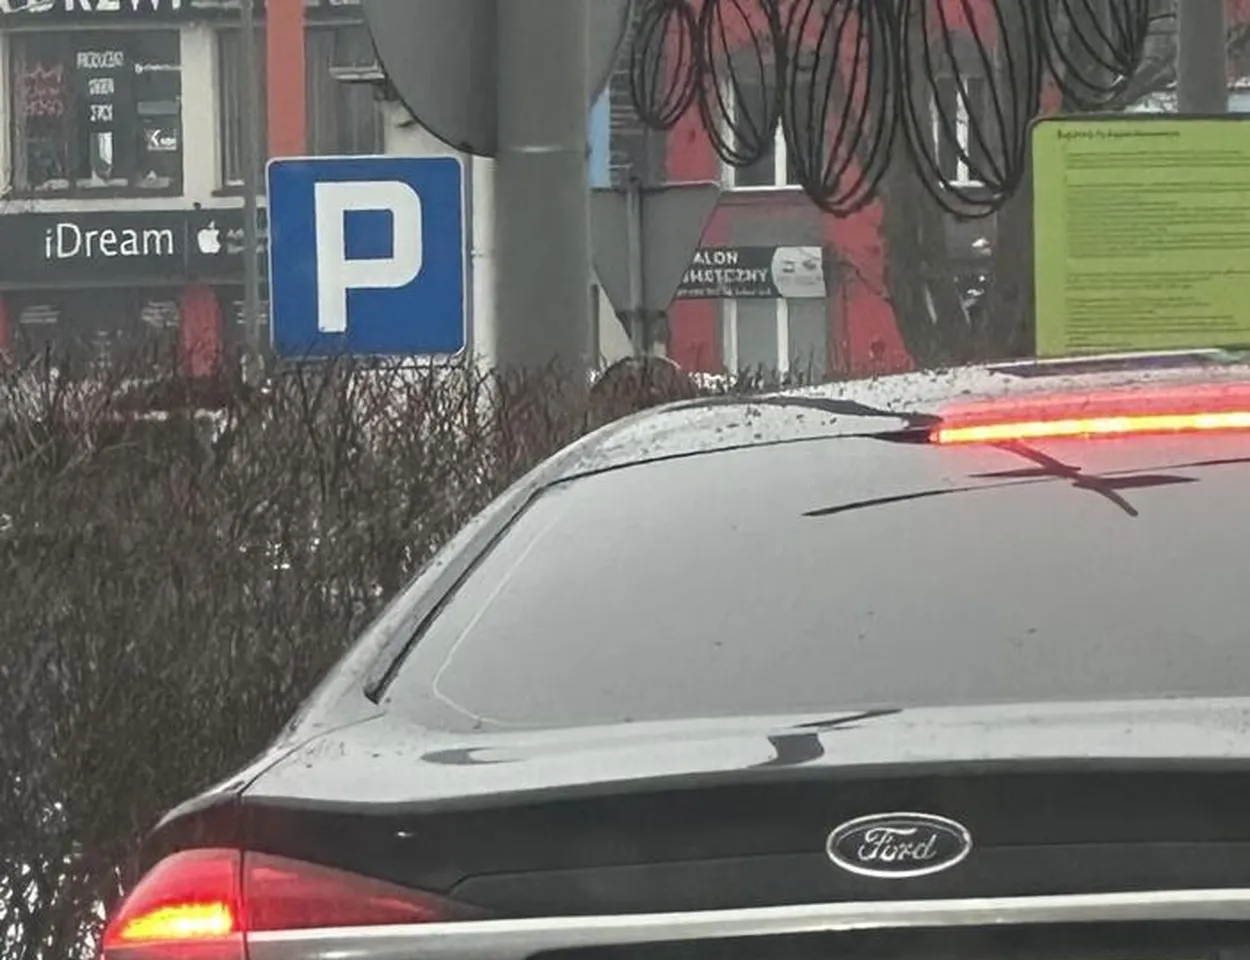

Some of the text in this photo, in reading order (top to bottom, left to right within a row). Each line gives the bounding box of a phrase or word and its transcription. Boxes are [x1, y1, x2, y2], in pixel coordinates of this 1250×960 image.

[45, 222, 174, 259] iDream
[314, 181, 422, 333] P
[693, 251, 739, 265] ALON
[858, 826, 938, 862] Ford
